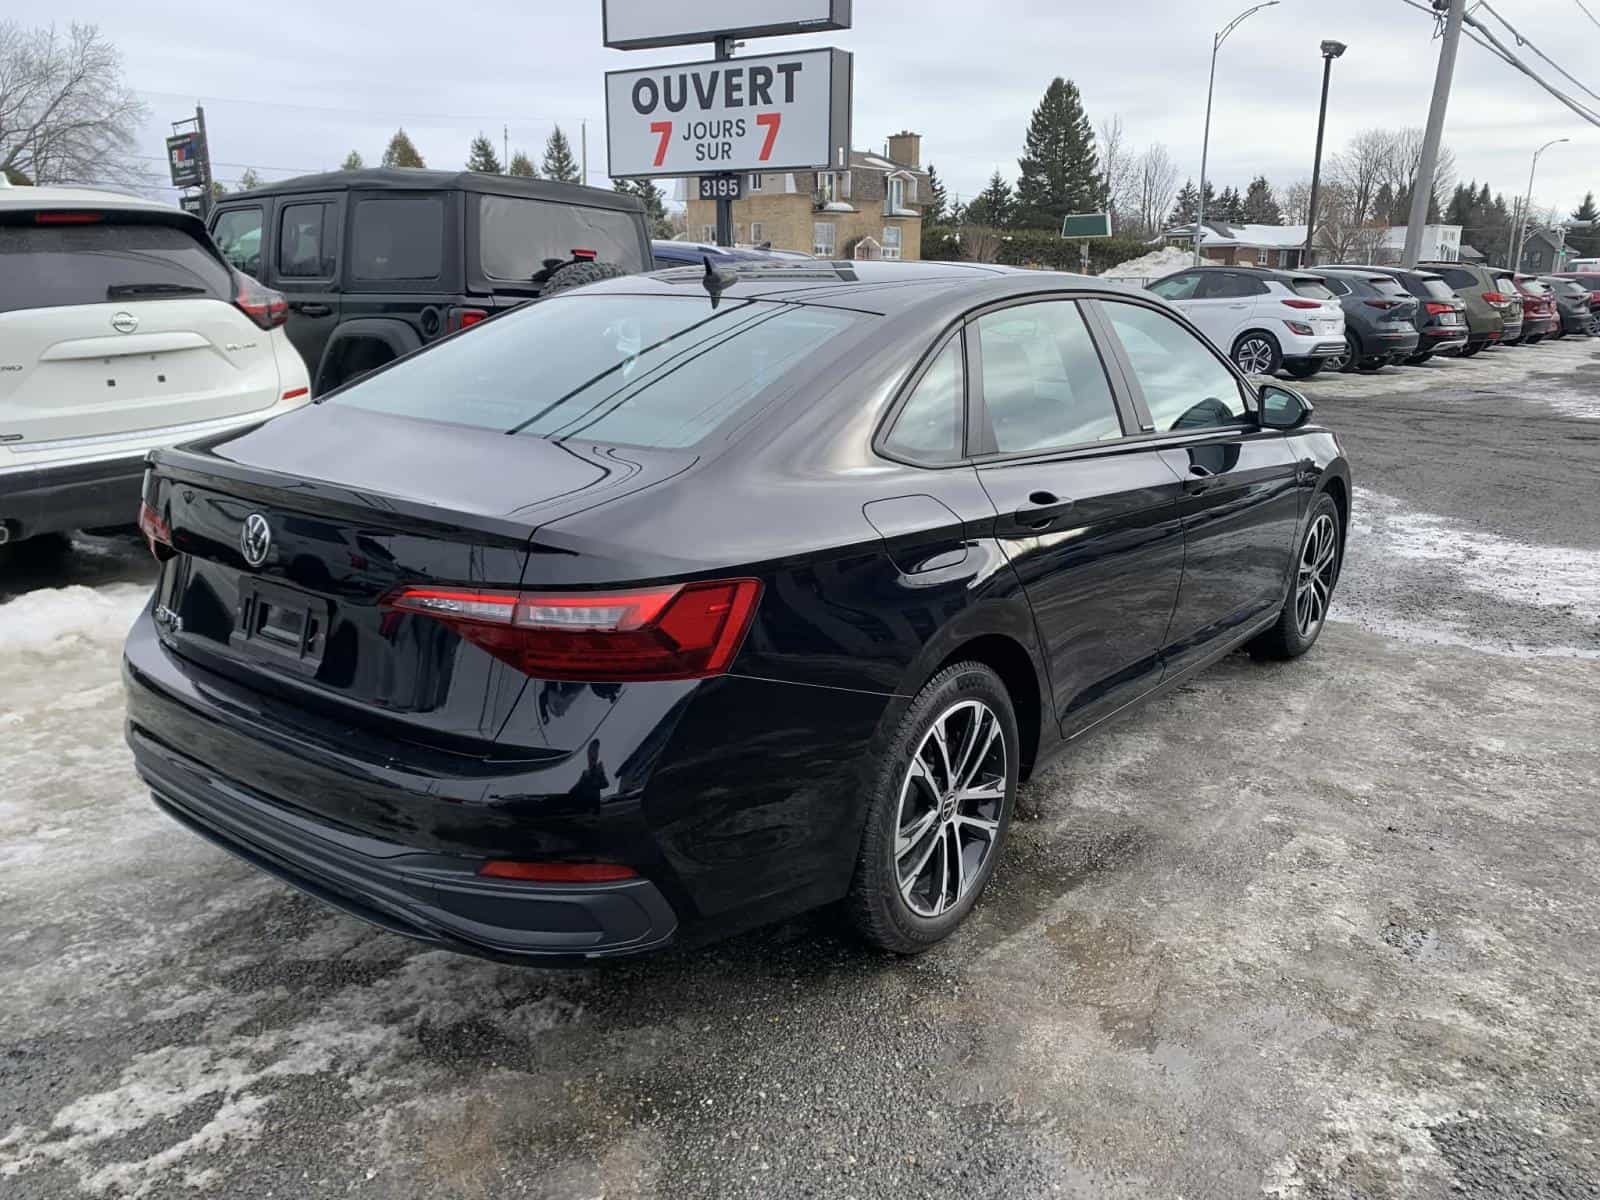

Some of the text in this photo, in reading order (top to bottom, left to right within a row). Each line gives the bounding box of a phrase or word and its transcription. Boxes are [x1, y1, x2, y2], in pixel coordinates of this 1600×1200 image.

[631, 62, 802, 115] OUVERT
[650, 121, 672, 167] 7
[682, 118, 746, 141] JOURS
[756, 112, 781, 161] 7
[695, 142, 732, 161] SUR
[702, 179, 738, 196] 3195
